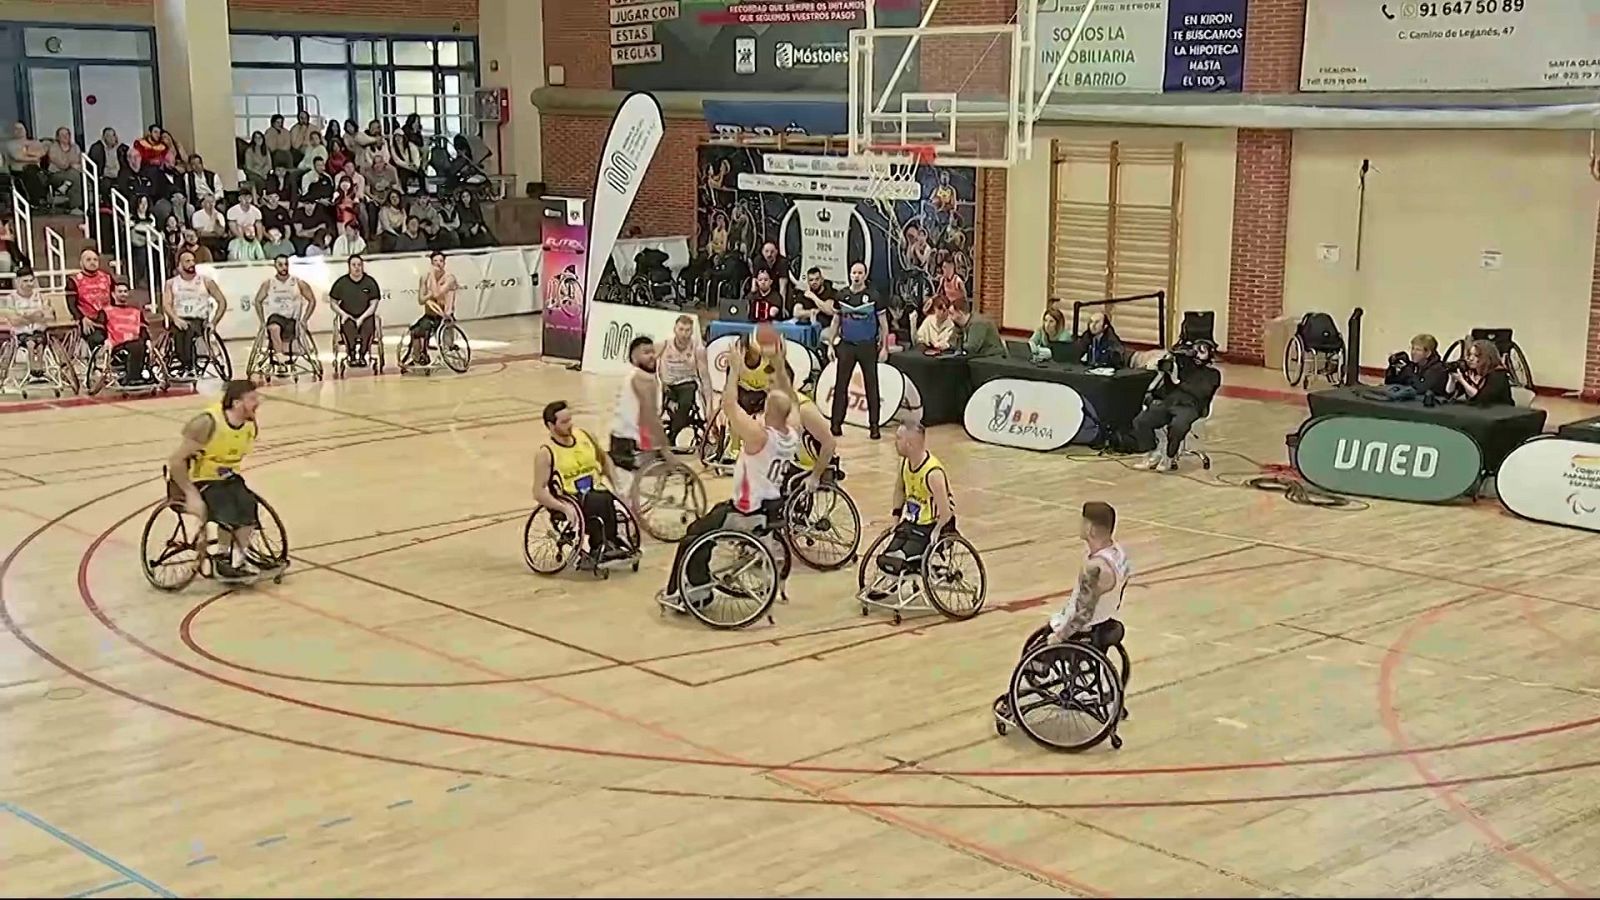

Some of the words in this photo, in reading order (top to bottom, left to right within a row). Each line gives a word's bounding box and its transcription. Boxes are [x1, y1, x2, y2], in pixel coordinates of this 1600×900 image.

[816, 2, 827, 11] OS
[1419, 3, 1437, 17] 91
[1442, 1, 1472, 15] 647
[1476, 0, 1497, 14] 50
[1502, 0, 1524, 12] 89
[616, 9, 649, 22] JUGAR
[651, 6, 676, 19] CON
[831, 11, 856, 20] PASOS
[1184, 15, 1198, 25] EN
[1200, 13, 1233, 25] KIRON
[616, 28, 648, 41] ESTAS
[1108, 26, 1125, 40] LA
[1173, 31, 1183, 40] TE
[1185, 28, 1243, 40] BUSCAMOS
[1409, 30, 1443, 39] Camino
[1445, 28, 1457, 38] de
[1502, 26, 1515, 35] 47
[616, 46, 657, 60] REGLAS
[793, 48, 849, 63] Móstoles
[1174, 46, 1187, 55] LA
[1189, 44, 1239, 55] HIPOTECA
[1189, 61, 1221, 70] HASTA
[1074, 72, 1126, 86] BARRIO
[1183, 77, 1193, 86] EL
[1197, 76, 1214, 86] 100
[1008, 424, 1053, 440] ESPAÑA
[1334, 438, 1439, 479] UNED
